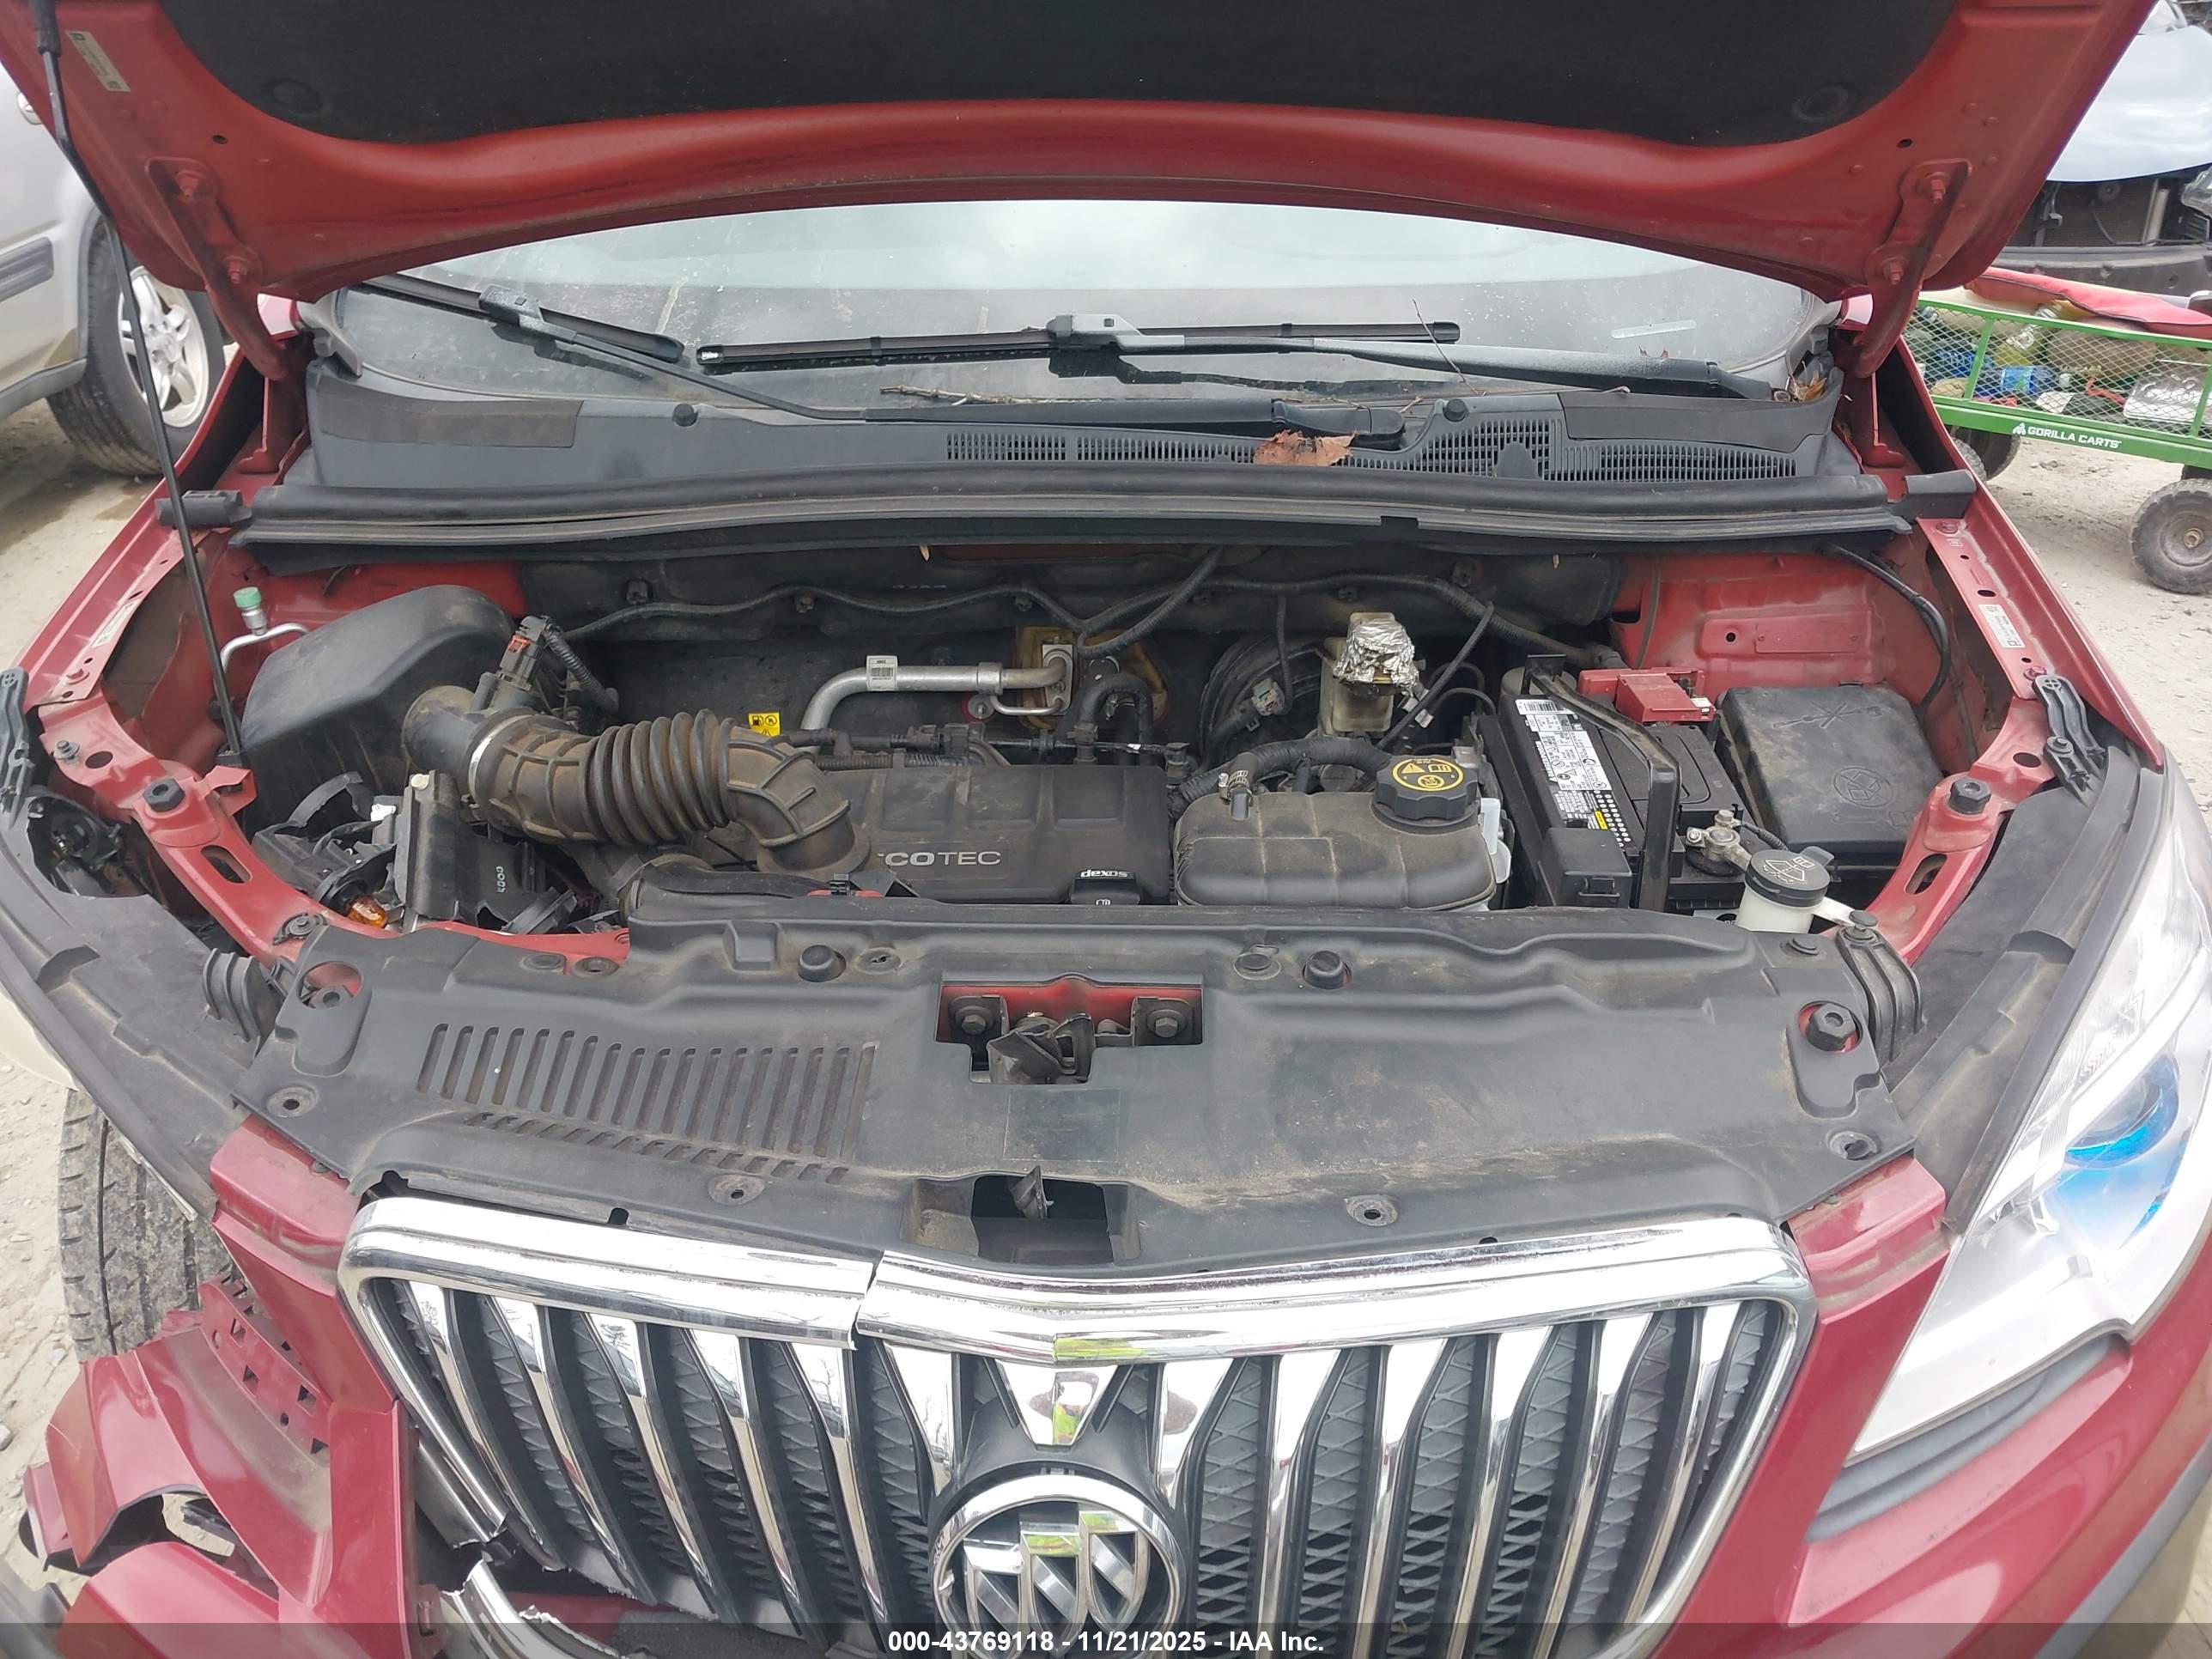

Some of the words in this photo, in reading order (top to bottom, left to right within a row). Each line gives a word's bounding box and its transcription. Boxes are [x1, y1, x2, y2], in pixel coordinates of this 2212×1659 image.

[2028, 427, 2076, 441] GORILLA
[2078, 434, 2119, 449] CARTS
[877, 850, 1001, 866] COTEC
[1080, 869, 1129, 878] dexos
